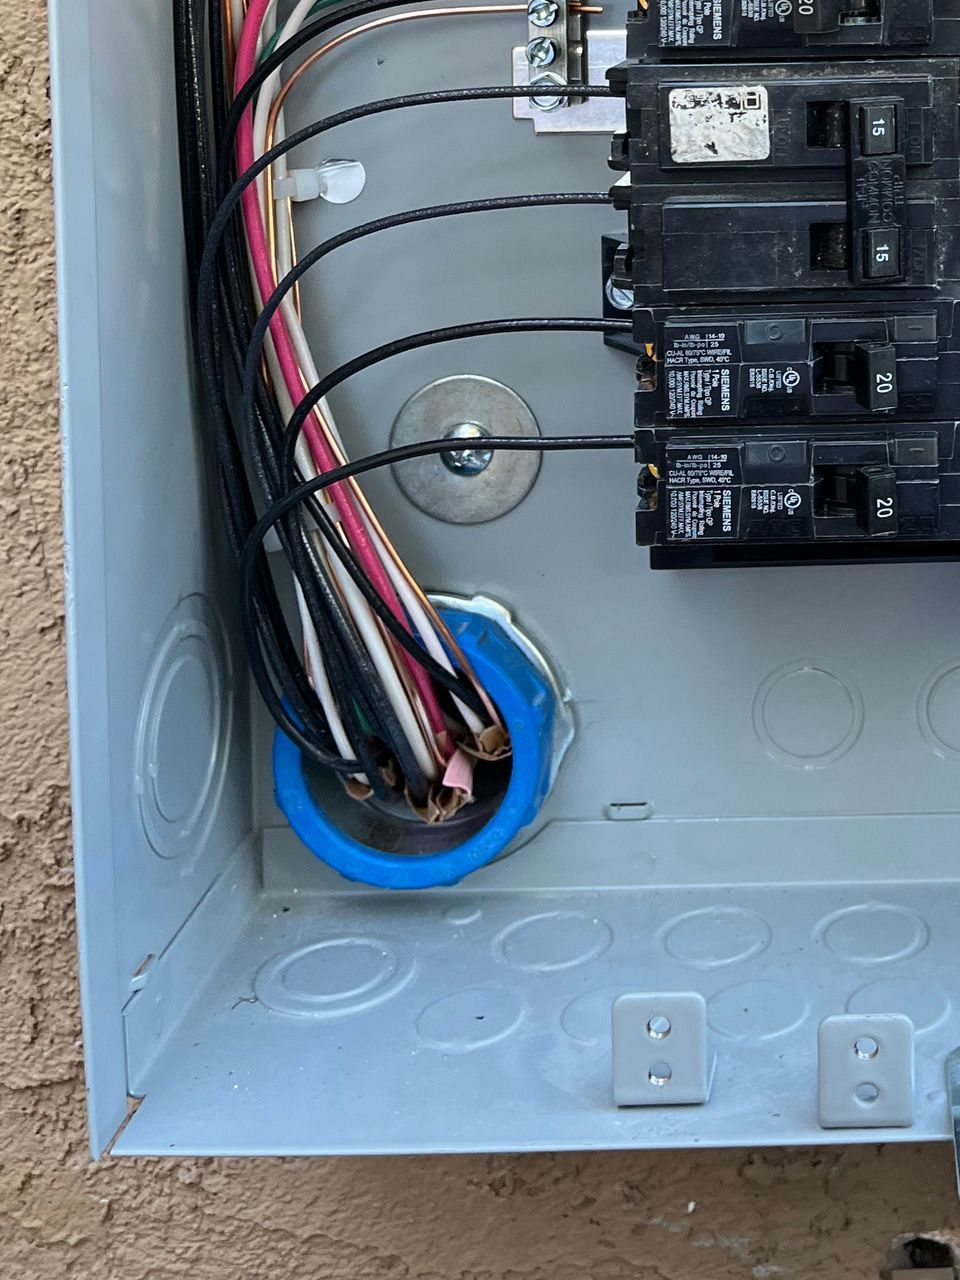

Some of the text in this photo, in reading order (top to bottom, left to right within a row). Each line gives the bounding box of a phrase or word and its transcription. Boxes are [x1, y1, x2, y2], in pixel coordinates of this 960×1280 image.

[873, 119, 885, 135] 15
[876, 244, 889, 261] 15
[721, 369, 730, 411] SIEMENS
[877, 373, 892, 393] 20
[723, 490, 731, 531] SIEMENS
[877, 498, 893, 517] 20
